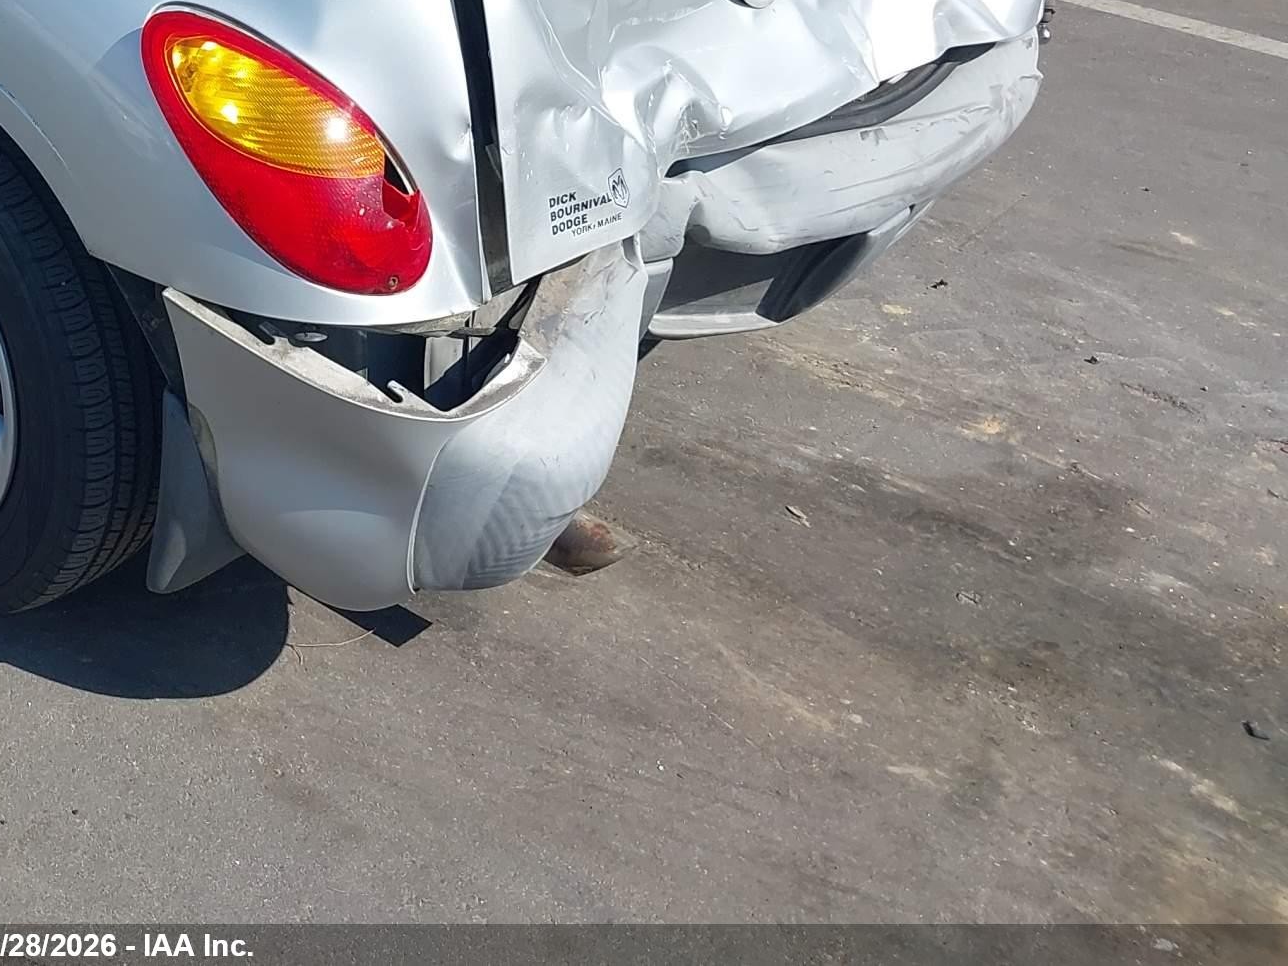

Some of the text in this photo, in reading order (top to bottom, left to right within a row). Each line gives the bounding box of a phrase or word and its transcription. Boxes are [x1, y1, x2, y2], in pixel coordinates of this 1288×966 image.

[549, 192, 577, 208] DICK
[550, 193, 612, 222] BOURNIVAL
[552, 214, 588, 236] DODGE
[597, 212, 622, 228] MAINE
